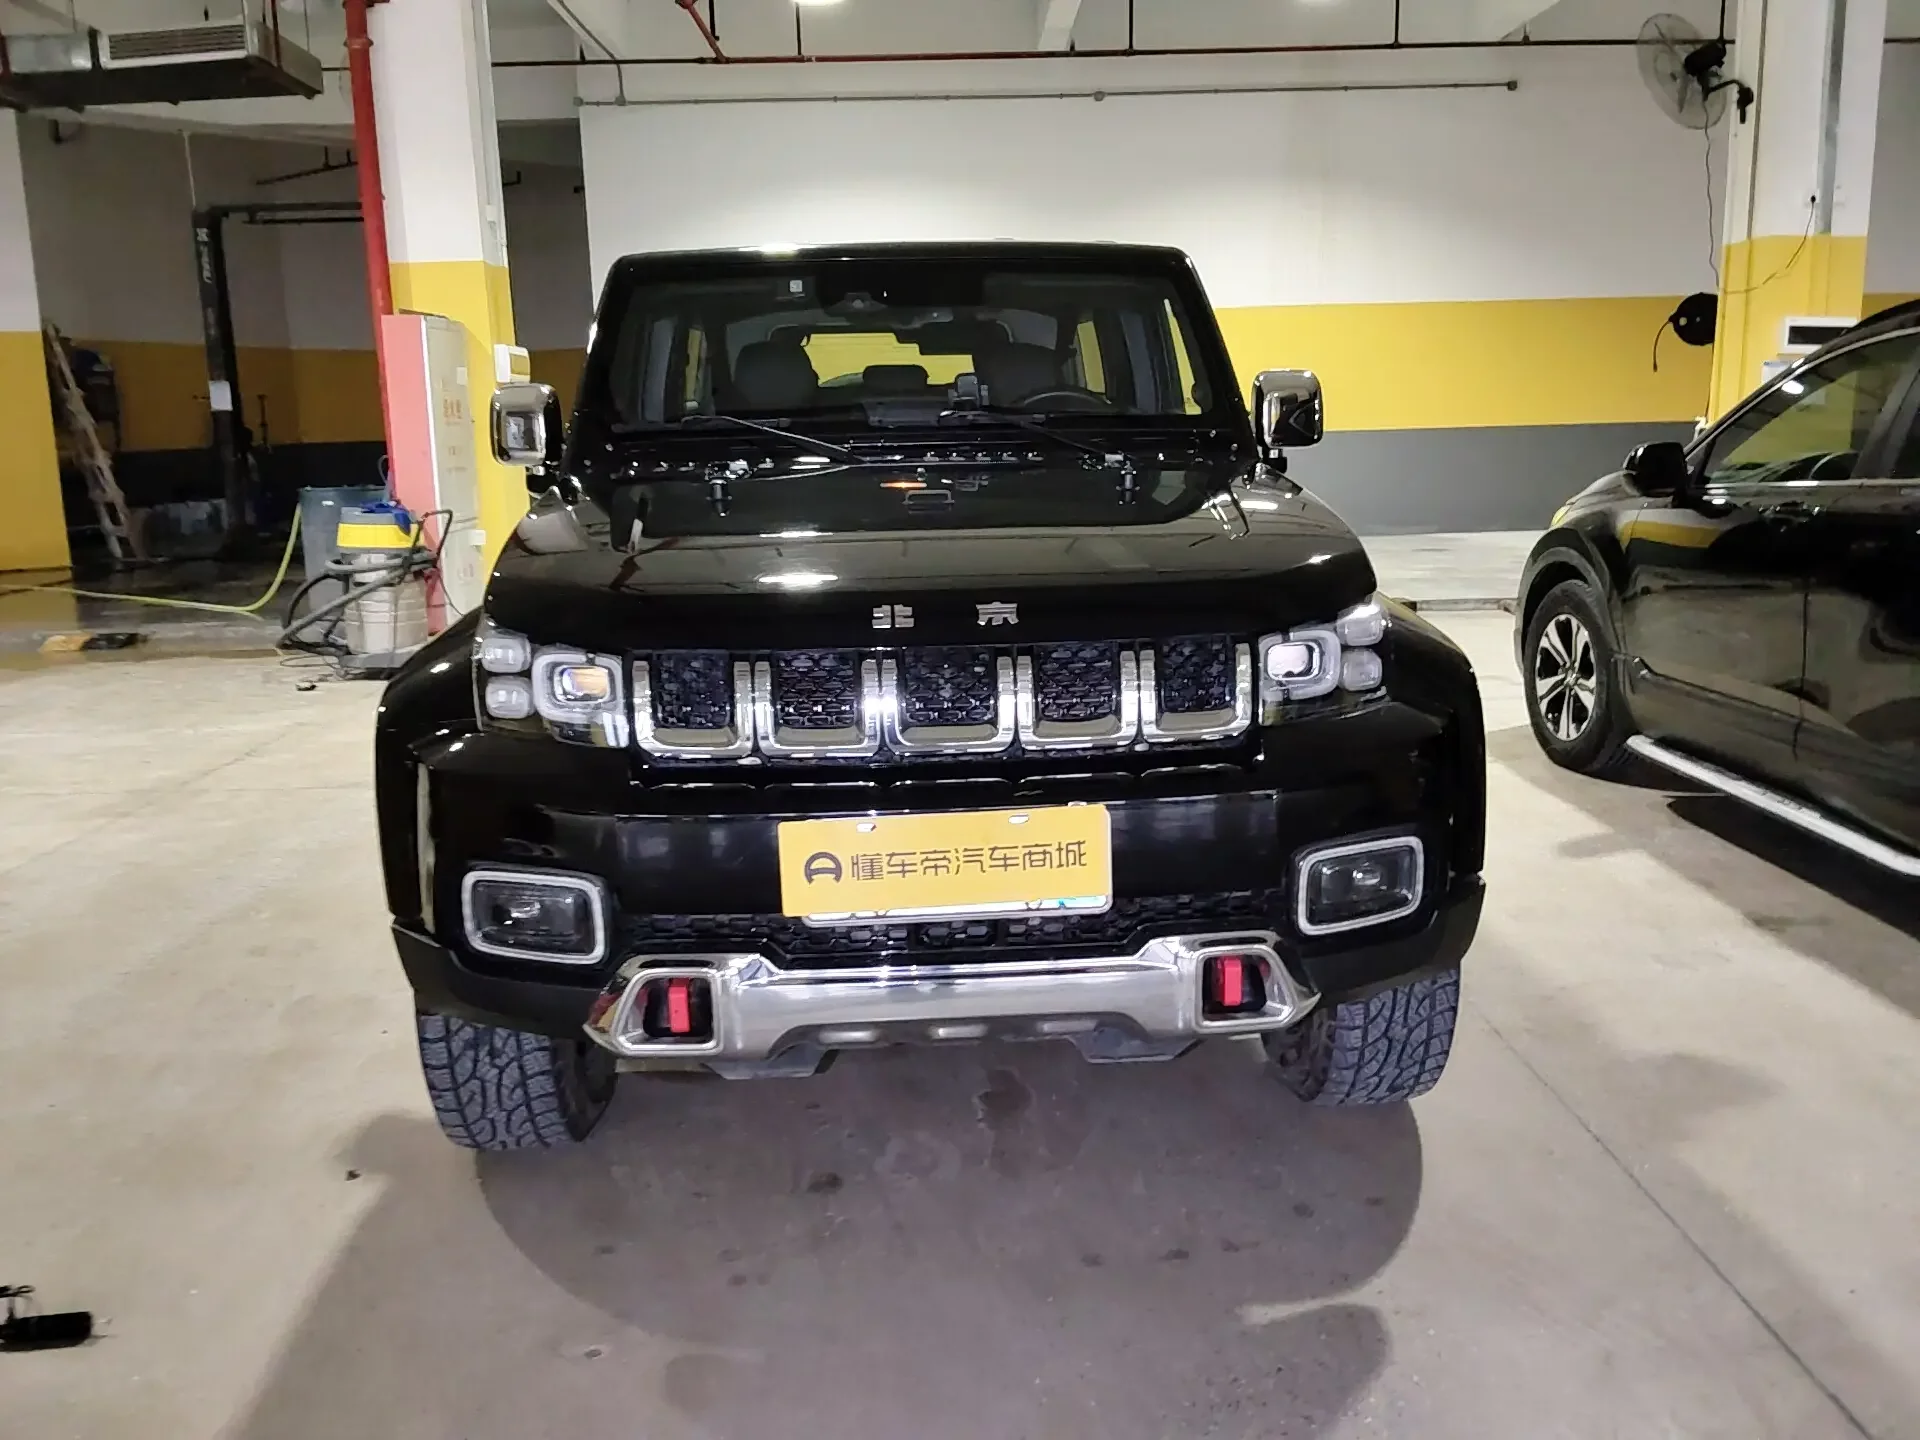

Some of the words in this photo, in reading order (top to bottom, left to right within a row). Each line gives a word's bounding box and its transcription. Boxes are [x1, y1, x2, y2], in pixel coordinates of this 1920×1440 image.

[872, 601, 1019, 629] 北京
[851, 840, 1088, 882] 懂车帝汽车商城
